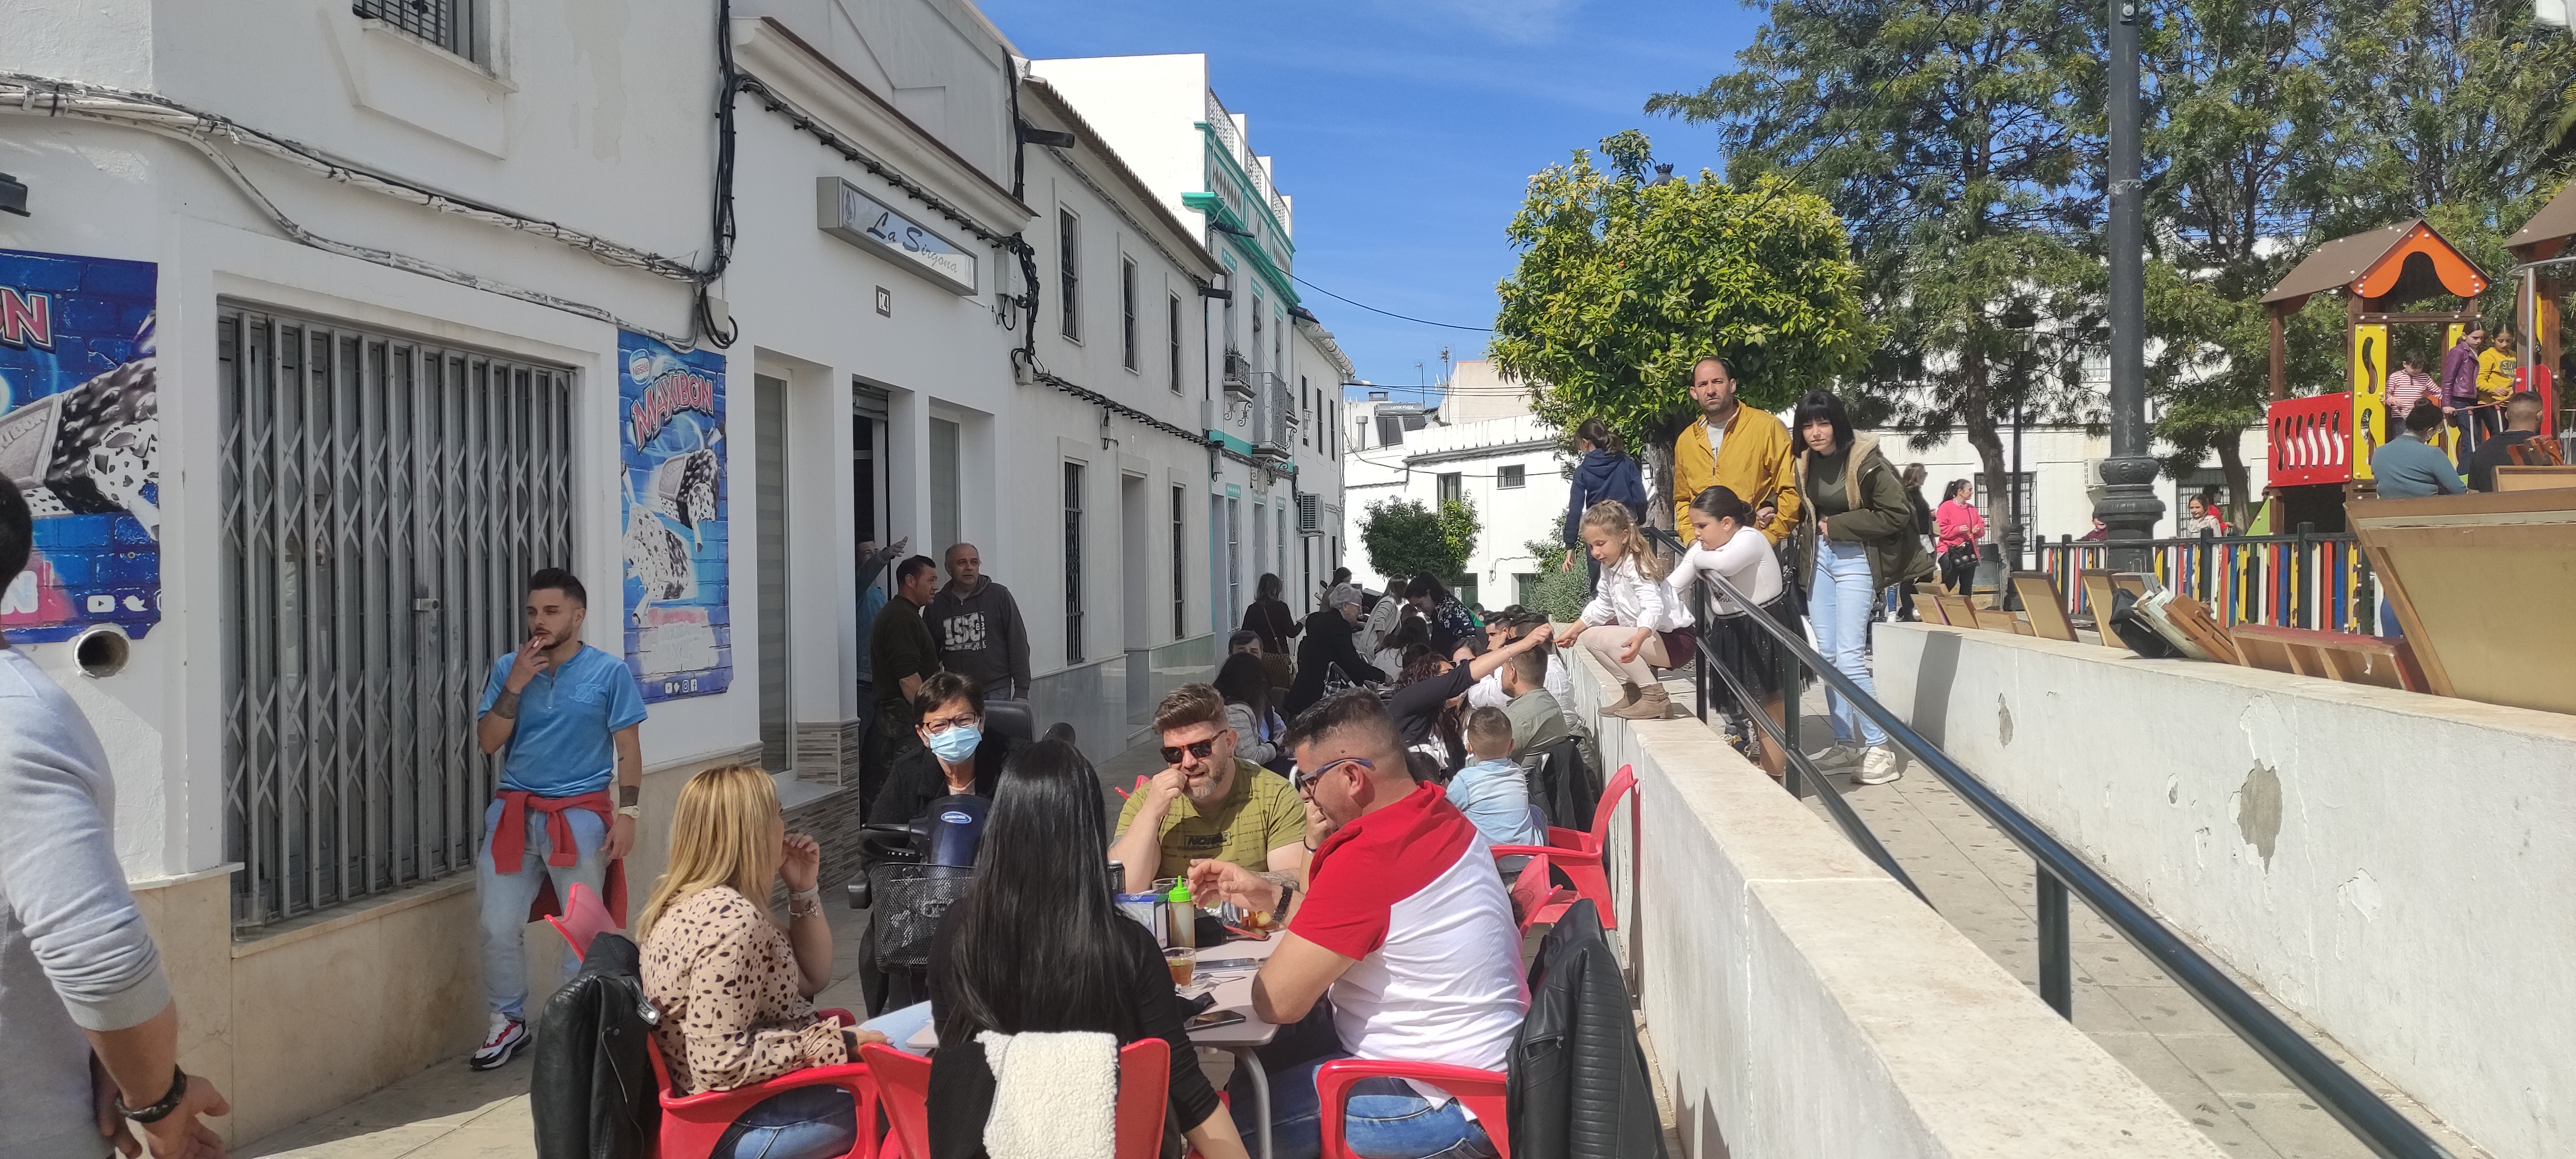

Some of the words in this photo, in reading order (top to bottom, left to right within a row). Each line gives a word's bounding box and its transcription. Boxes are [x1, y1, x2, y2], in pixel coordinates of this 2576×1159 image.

[866, 211, 897, 243] La
[902, 227, 958, 273] Sirgona
[631, 369, 715, 454] MAXIBON
